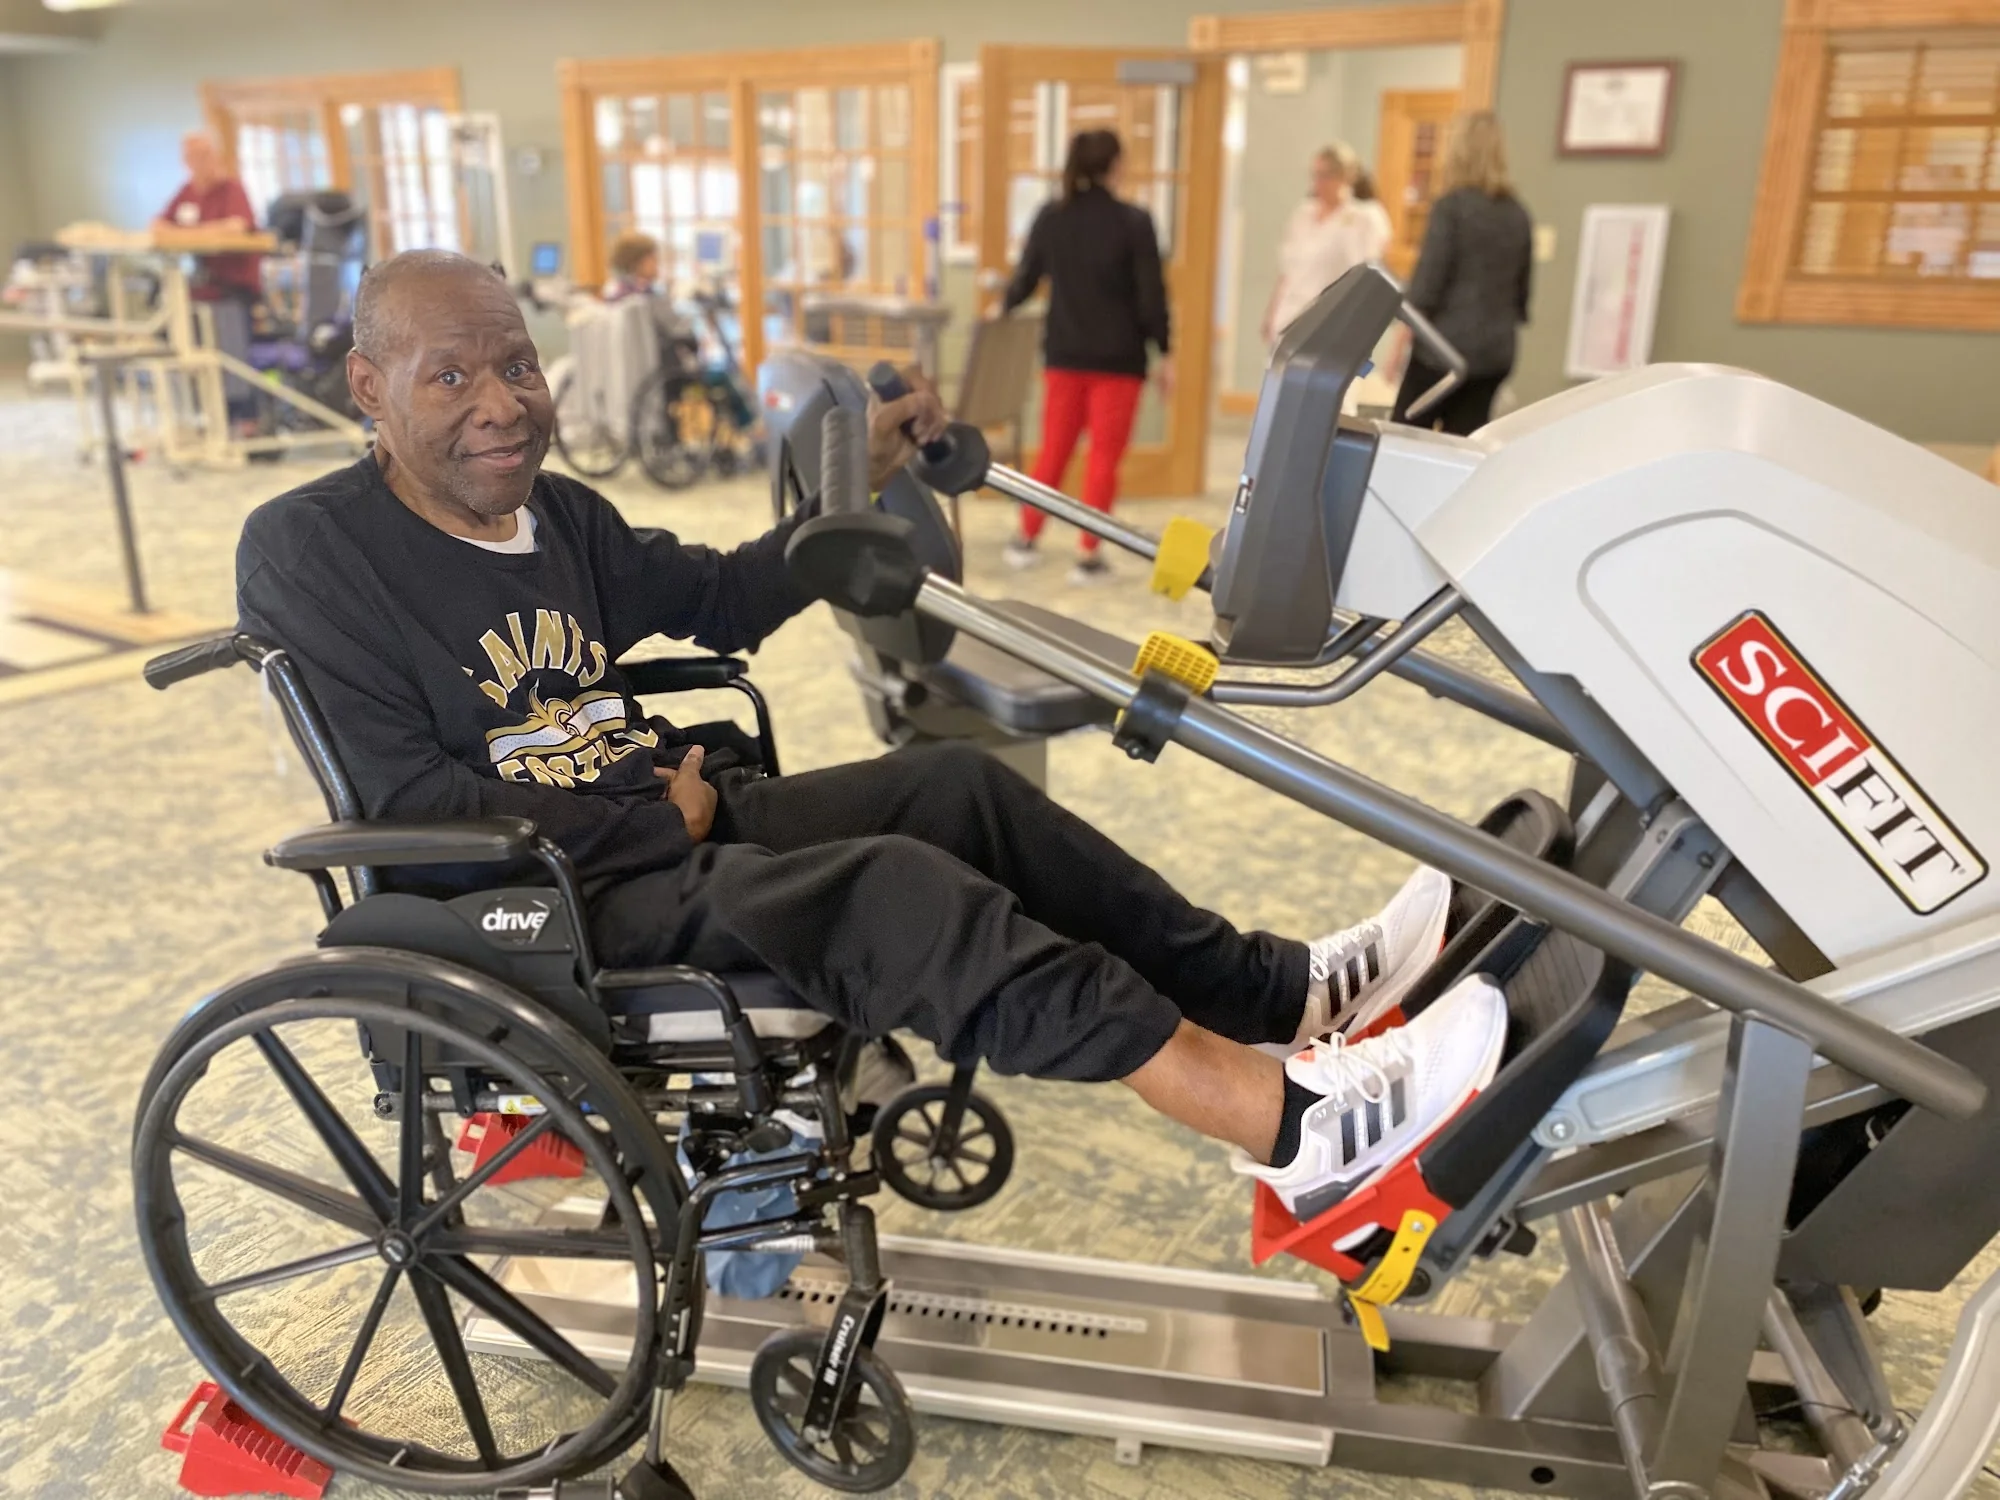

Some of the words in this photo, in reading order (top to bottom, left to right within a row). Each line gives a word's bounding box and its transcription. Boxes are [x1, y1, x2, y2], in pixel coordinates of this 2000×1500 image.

[1716, 640, 1962, 882] SCIFIT
[482, 907, 547, 931] drive
[828, 1314, 855, 1369] Cruiser
